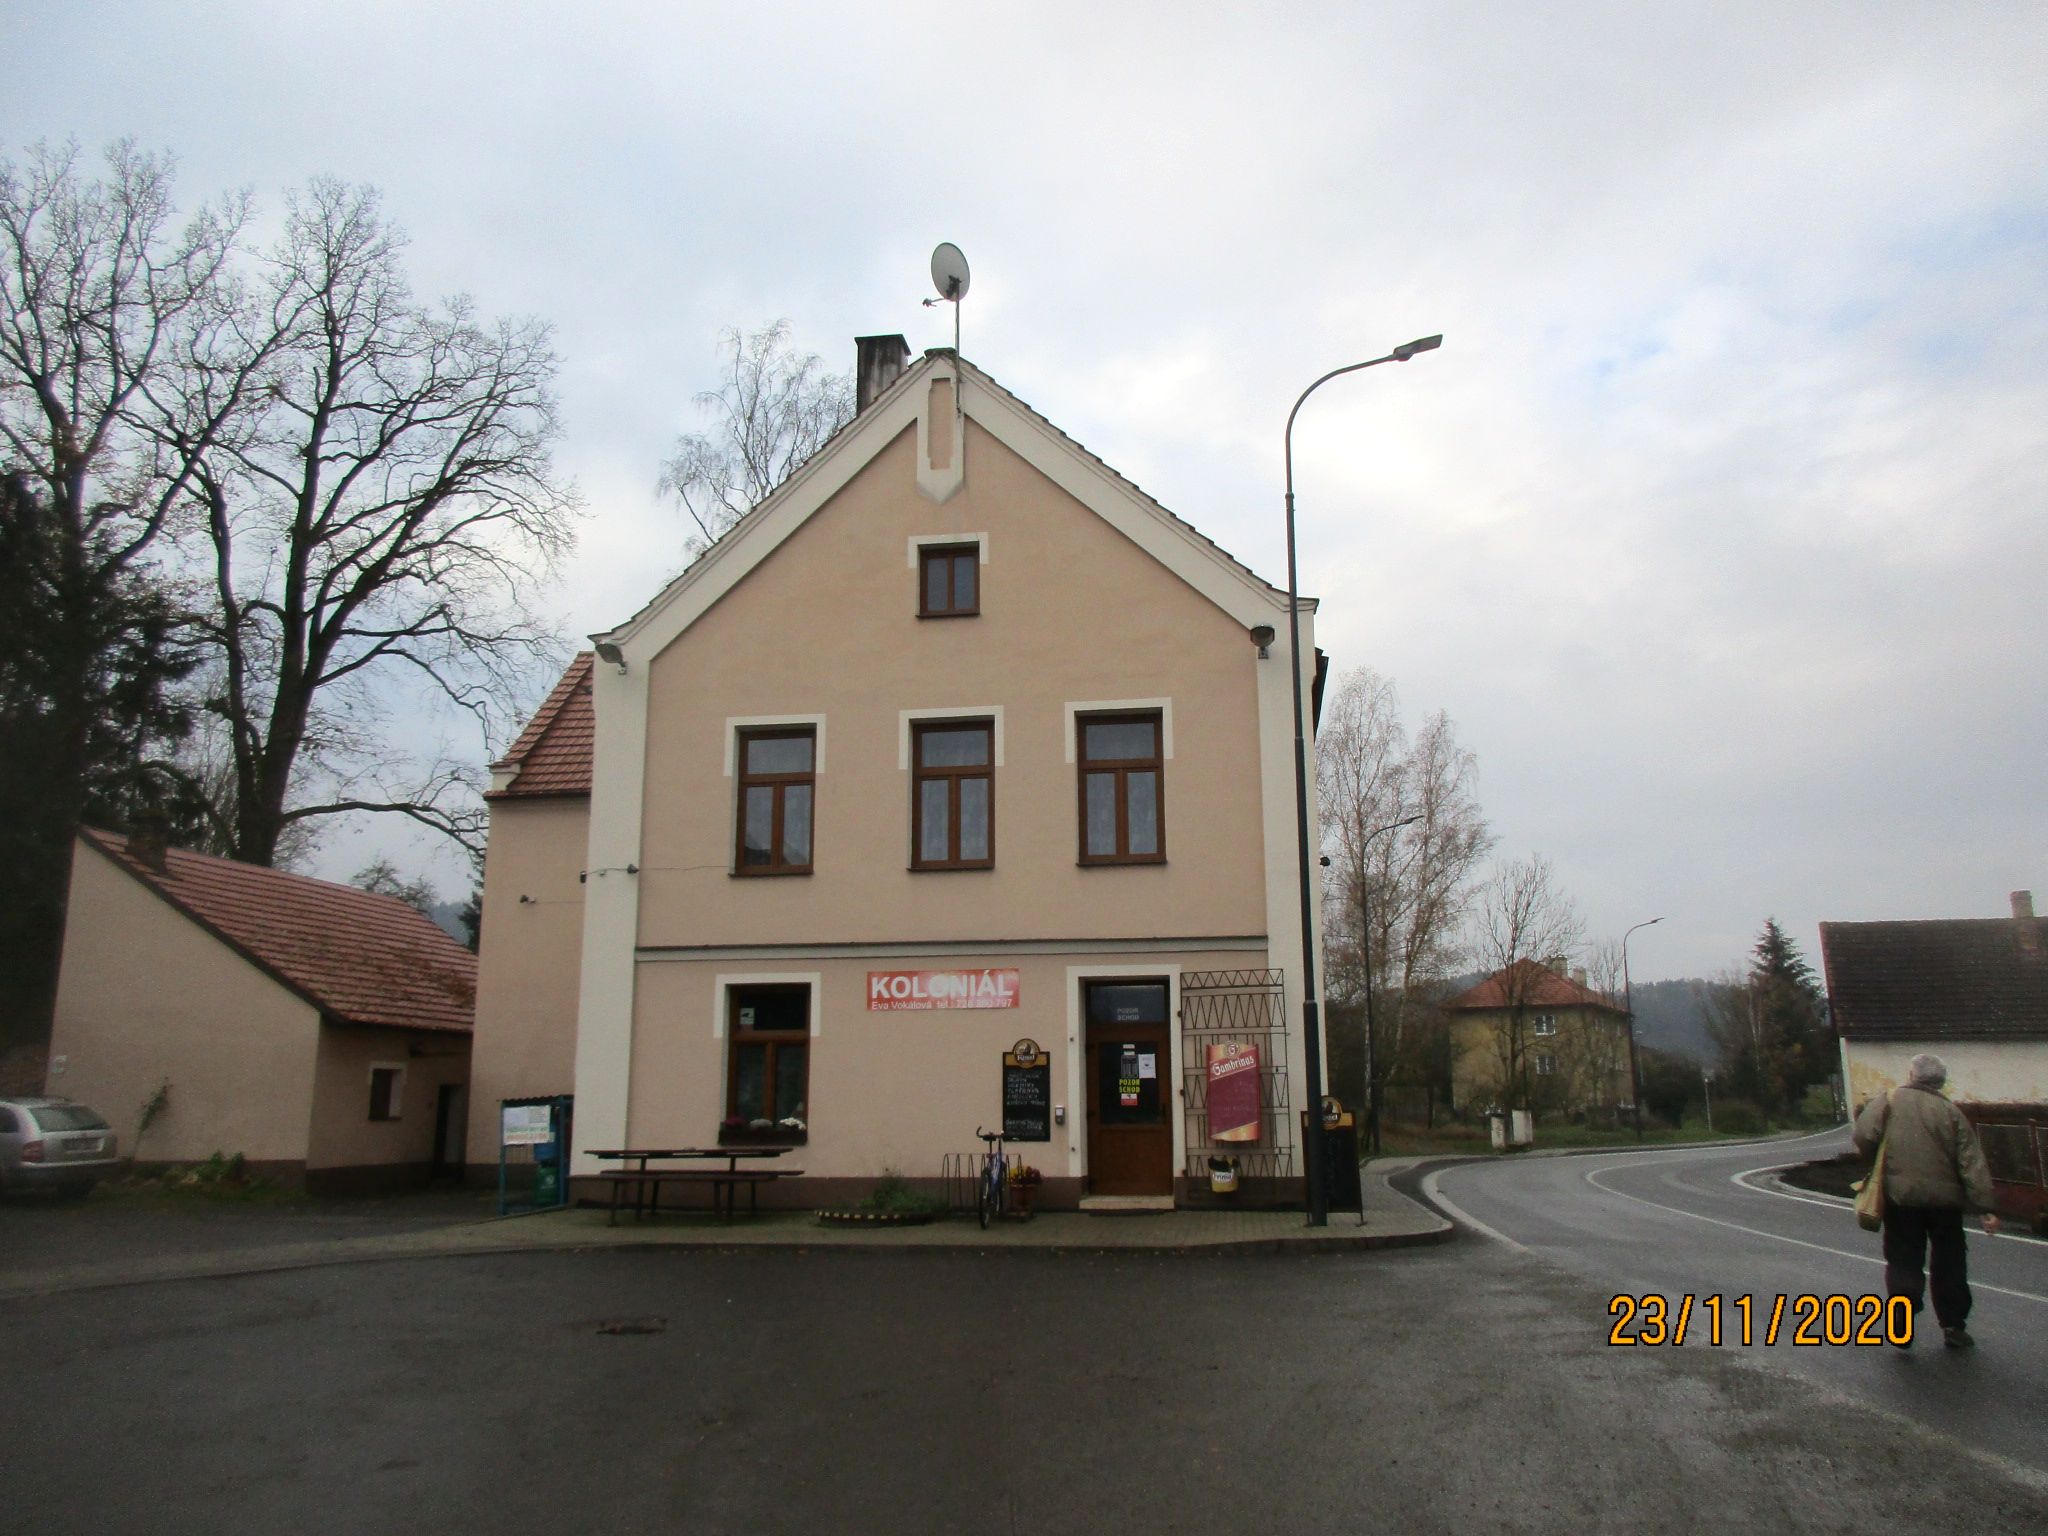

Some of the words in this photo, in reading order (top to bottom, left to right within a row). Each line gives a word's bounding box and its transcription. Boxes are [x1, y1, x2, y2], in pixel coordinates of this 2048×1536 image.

[871, 969, 1014, 998] KOLONIÁL
[871, 1001, 889, 1010] Eva
[1212, 1055, 1255, 1076] Gambrinus
